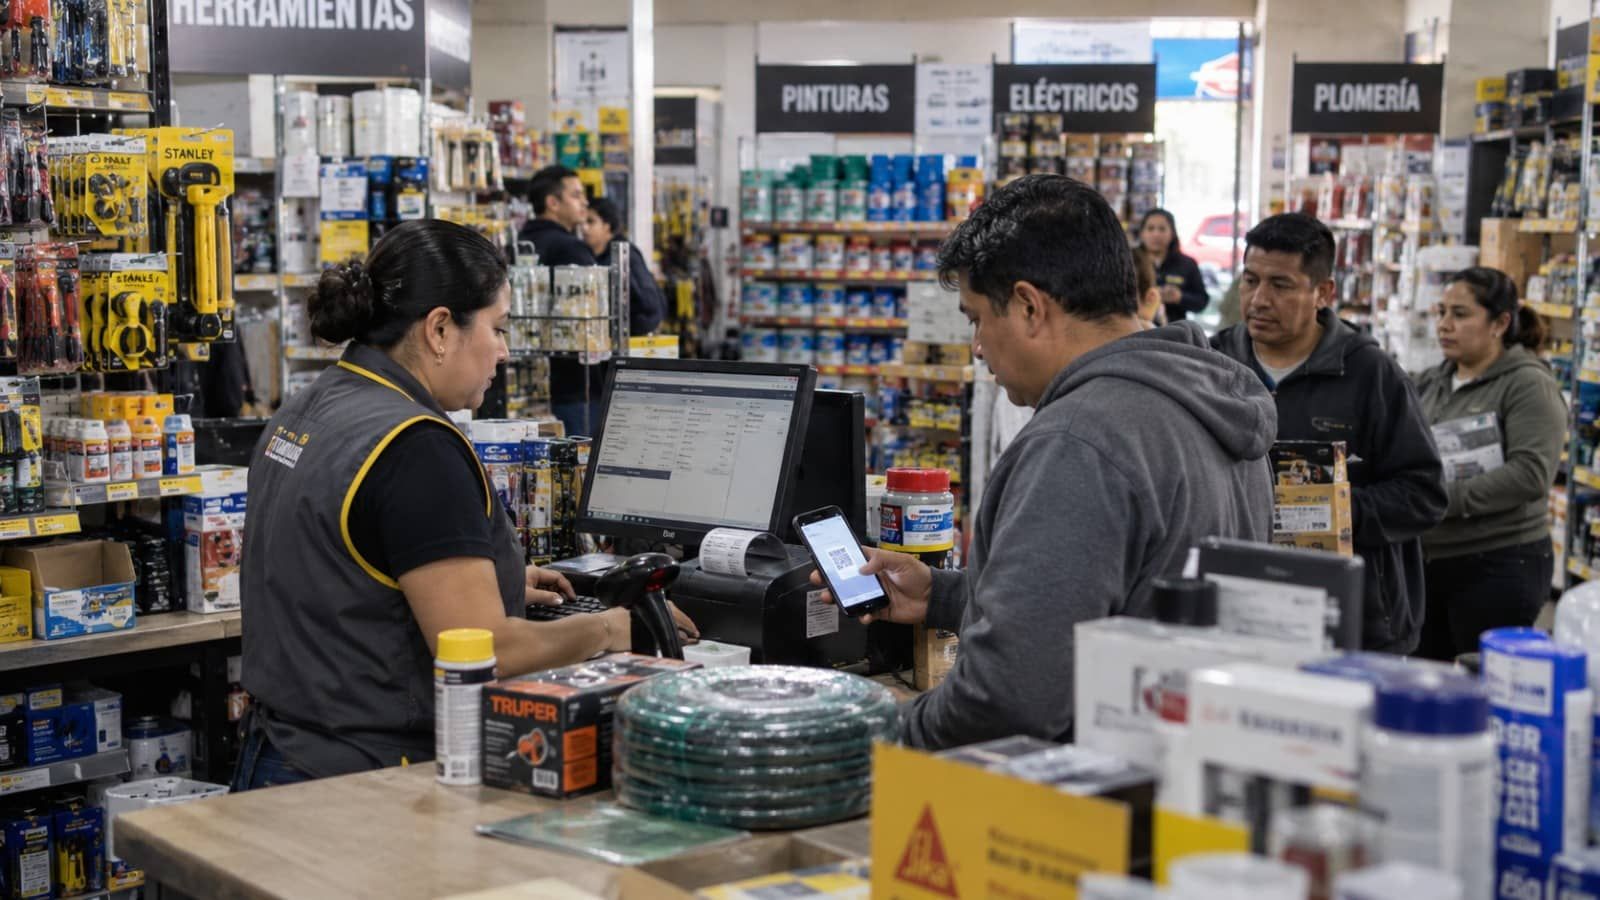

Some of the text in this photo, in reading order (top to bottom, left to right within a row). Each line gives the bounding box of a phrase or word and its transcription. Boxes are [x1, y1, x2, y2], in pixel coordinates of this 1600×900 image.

[781, 84, 890, 113] PINTURAS
[1010, 78, 1138, 112] ELÉCTRICOS
[1315, 77, 1421, 112] PLOMERÍA
[164, 148, 214, 160] STANLEY
[491, 695, 558, 722] TRUPER
